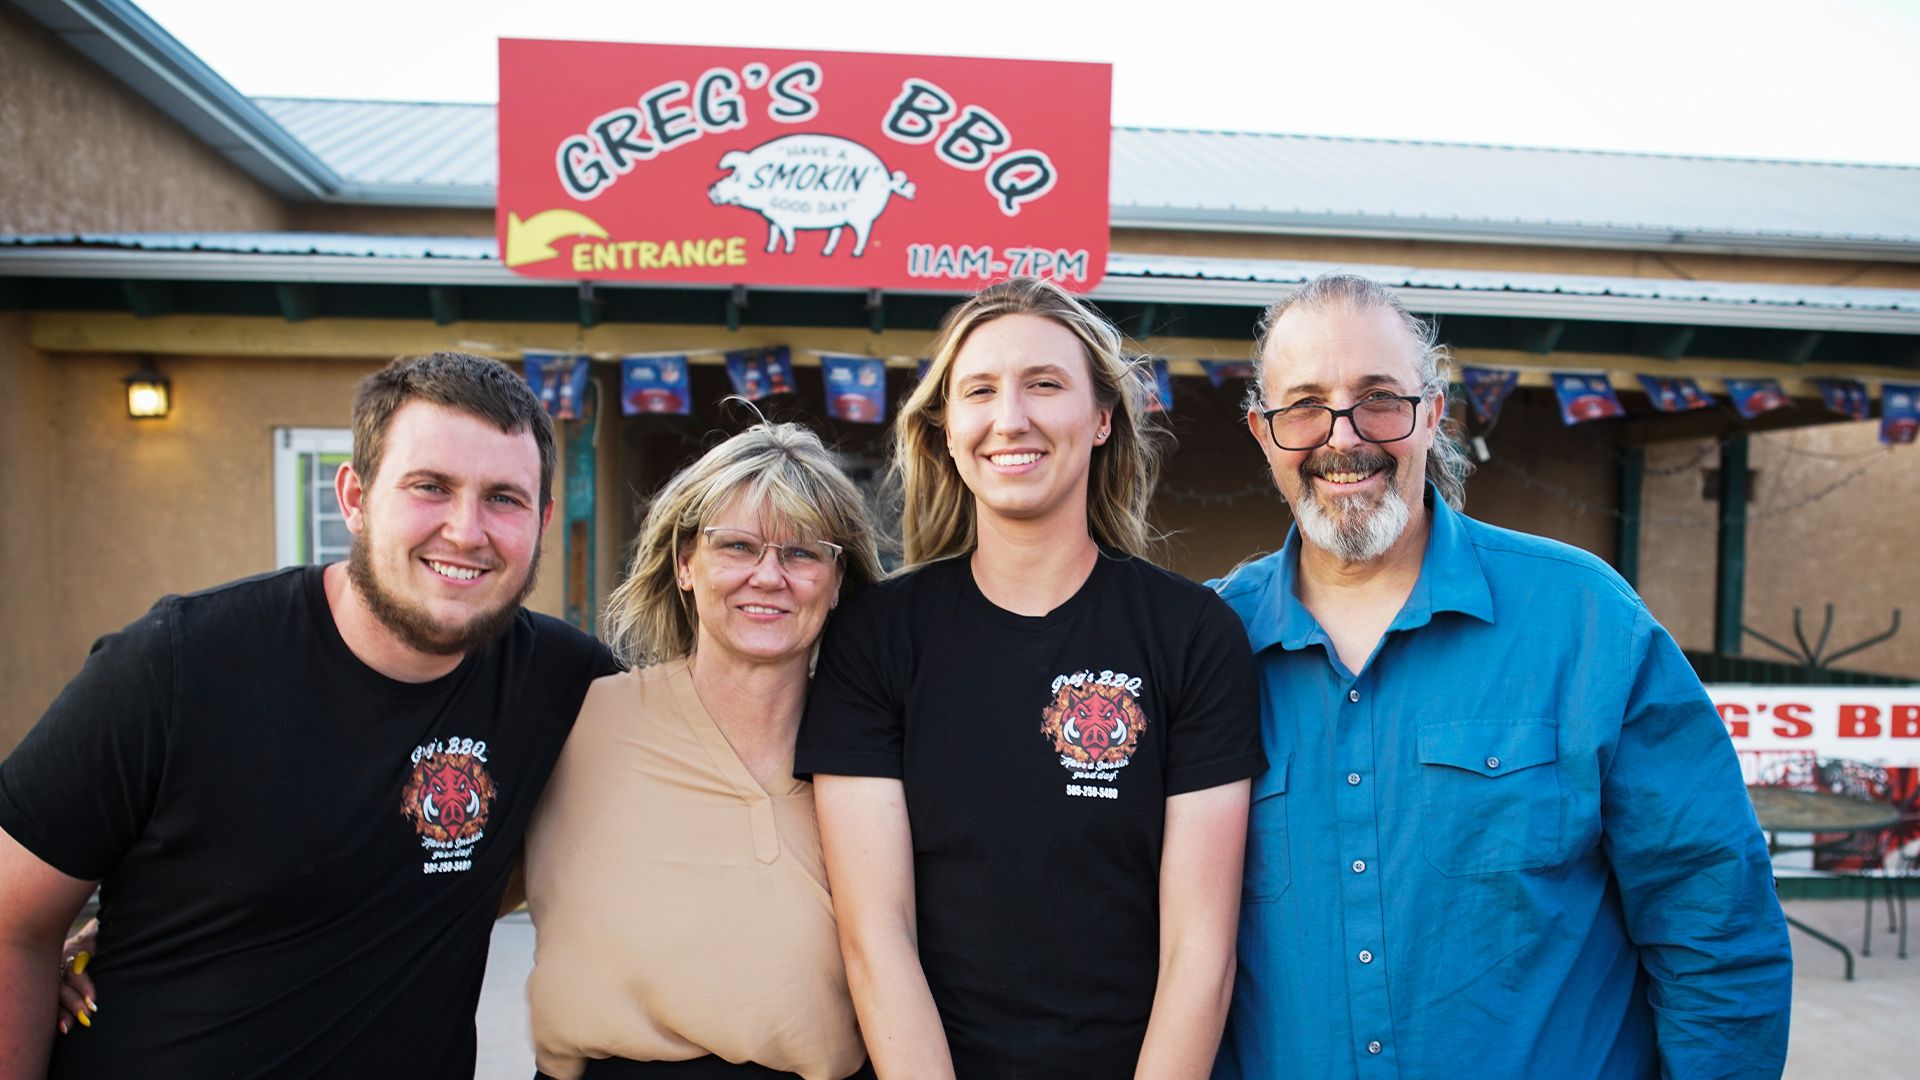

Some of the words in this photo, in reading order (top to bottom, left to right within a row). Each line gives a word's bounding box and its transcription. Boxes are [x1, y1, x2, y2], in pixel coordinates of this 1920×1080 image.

[558, 63, 821, 198] GREG'S
[885, 80, 1055, 214] BBQ
[837, 149, 848, 159] A
[769, 197, 811, 213] GOOD
[571, 238, 747, 271] ENTRANCE
[907, 244, 1089, 282] 11AM-7PM
[1095, 670, 1142, 697] BBQ
[445, 736, 488, 763] BBQ
